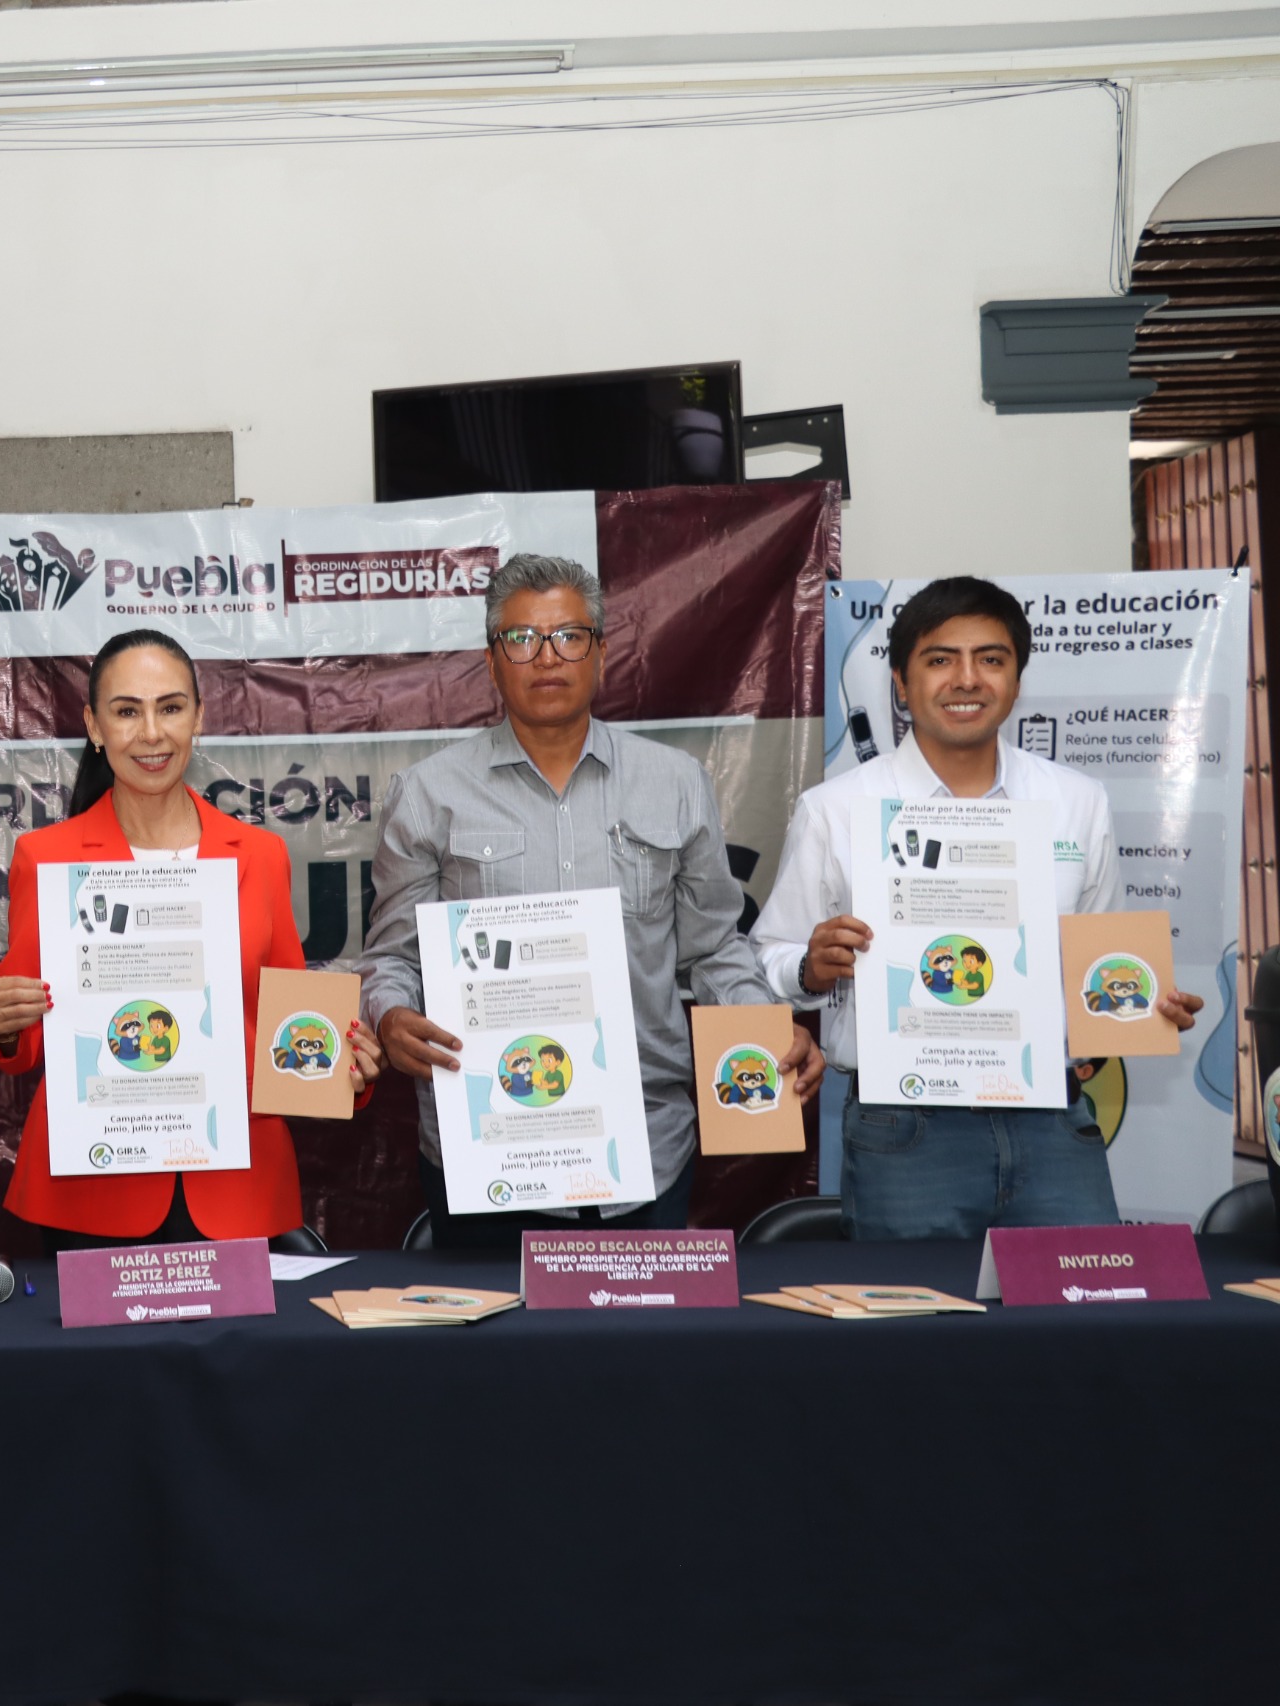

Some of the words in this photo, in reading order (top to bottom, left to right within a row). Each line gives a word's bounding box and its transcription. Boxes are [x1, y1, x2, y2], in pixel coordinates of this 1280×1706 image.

[294, 558, 388, 573] COORDINACIÓN
[391, 558, 408, 569] DE
[411, 558, 433, 568] LAS
[104, 554, 276, 598] Puebla
[294, 562, 490, 596] REGIDURÍAS
[1044, 595, 1066, 615] la
[1076, 589, 1218, 614] educación
[106, 604, 177, 615] GOBIERNO
[183, 604, 198, 614] DE
[202, 603, 218, 613] LA
[851, 601, 883, 620] Un
[1059, 627, 1068, 637] a
[1074, 624, 1091, 636] tu
[1097, 621, 1156, 635] celular
[1162, 623, 1172, 637] y
[1031, 642, 1050, 653] su
[1055, 639, 1119, 656] regreso
[1125, 640, 1135, 650] a
[1141, 637, 1193, 650] clases
[1066, 707, 1108, 725] ¿QUÉ
[1065, 734, 1107, 745] Reúne
[1112, 735, 1132, 745] tus
[1065, 753, 1102, 766] viejos
[1199, 752, 1221, 764] no)
[905, 805, 935, 813] celular
[966, 806, 1011, 814] educación
[1118, 846, 1178, 858] tención
[1183, 849, 1192, 861] y
[93, 869, 121, 877] celular
[125, 869, 139, 877] por
[1126, 885, 1182, 899] Puebla)
[472, 905, 502, 914] celular
[505, 904, 519, 913] por
[522, 902, 530, 910] la
[533, 899, 578, 909] educación
[929, 1079, 959, 1088] GIRSA
[110, 1114, 152, 1123] Campaña
[155, 1113, 185, 1121] activa:
[104, 1125, 129, 1134] Junio,
[132, 1124, 152, 1133] julio
[162, 1123, 191, 1132] agosto
[117, 1147, 146, 1156] GIRSA
[516, 1182, 547, 1192] GIRSA
[530, 1241, 596, 1252] EDUARDO
[600, 1241, 672, 1252] ESCALONA
[676, 1238, 728, 1251] GARCÍA
[111, 1251, 160, 1268] MARÍA
[164, 1249, 217, 1265] ESTHER
[534, 1255, 577, 1263] MIEMBRO
[580, 1254, 642, 1263] PROPIETARIO
[645, 1254, 657, 1263] DE
[659, 1252, 729, 1263] GOBERNACIÓN
[1058, 1254, 1134, 1268] INVITADO
[547, 1263, 559, 1272] DE
[562, 1263, 573, 1272] LA
[576, 1263, 637, 1272] PRESIDENCIA
[640, 1263, 683, 1272] AUXILIAR
[687, 1262, 698, 1271] DE
[701, 1262, 714, 1271] LA
[120, 1269, 163, 1283] ORTIZ
[168, 1264, 210, 1279] PÉREZ
[608, 1271, 653, 1280] LIBERTAD
[119, 1282, 154, 1290] PRESIDENTA
[174, 1279, 204, 1287] COMISIÓN
[112, 1289, 143, 1298] ATENCIÓN
[150, 1286, 187, 1295] PROTECCIÓN
[612, 1293, 640, 1303] Puebla
[1085, 1289, 1113, 1298] Puebla
[149, 1307, 178, 1316] Puebla
